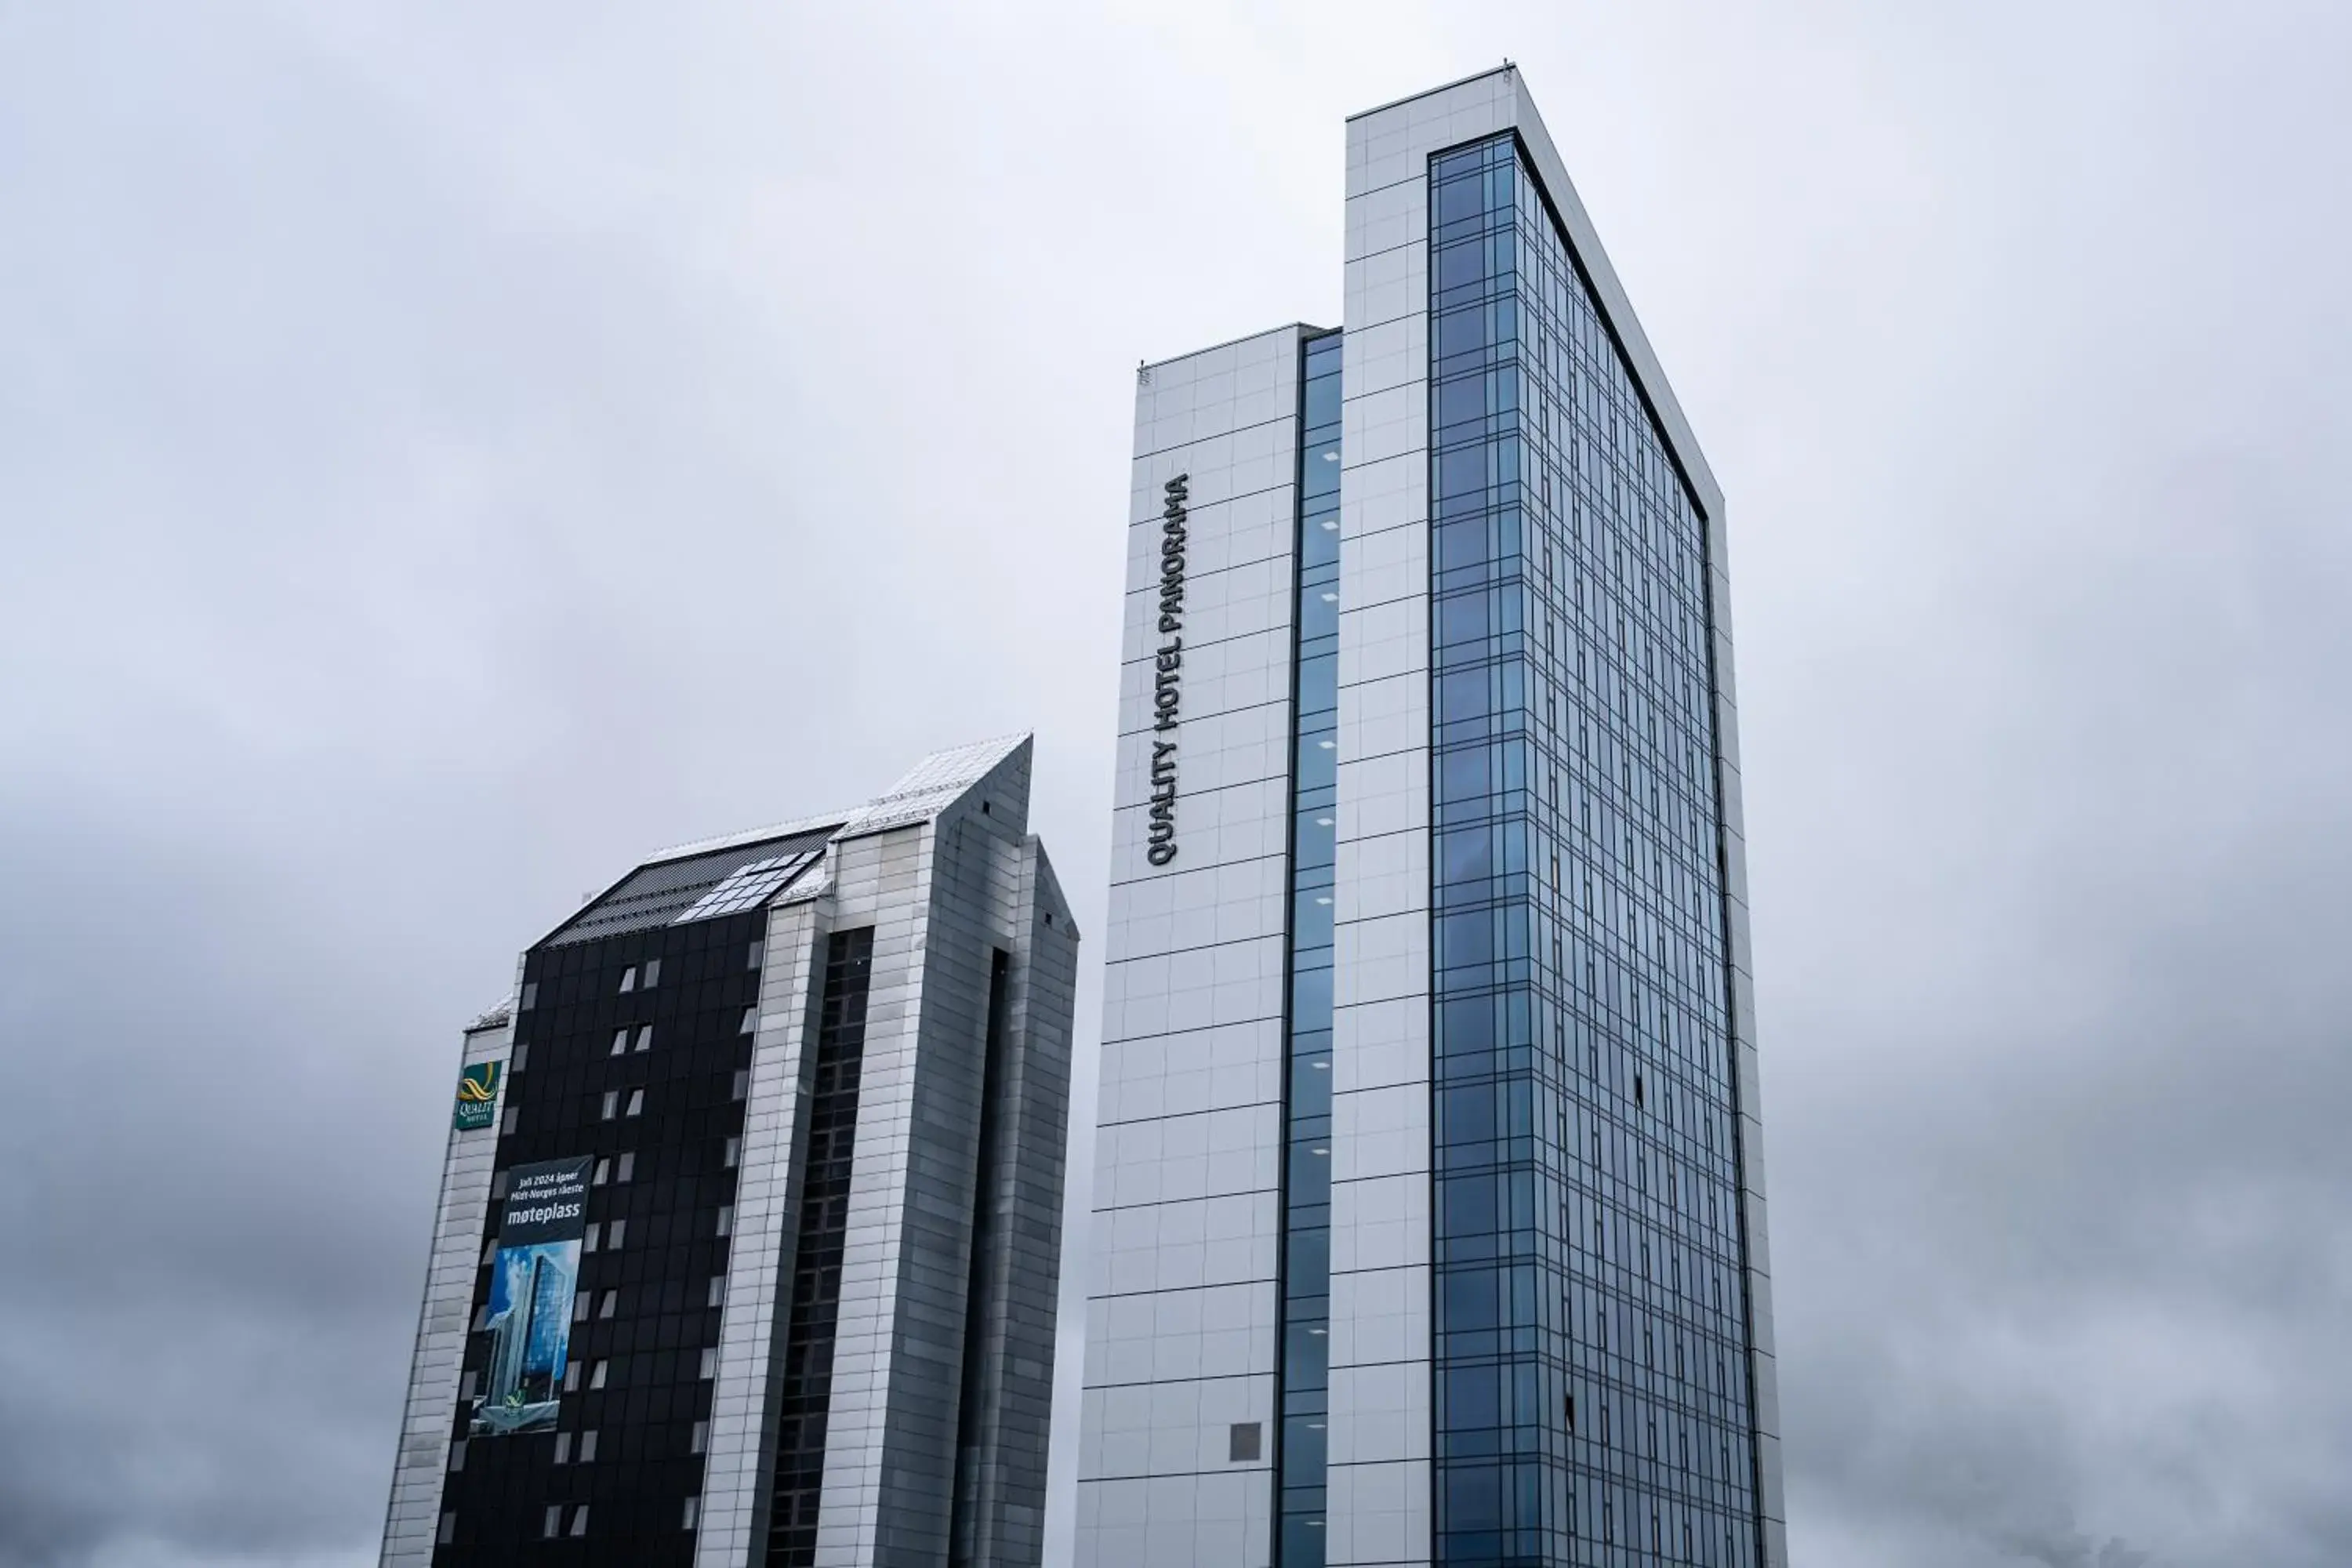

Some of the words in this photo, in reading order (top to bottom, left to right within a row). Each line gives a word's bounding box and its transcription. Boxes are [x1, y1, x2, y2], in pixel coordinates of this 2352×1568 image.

[1159, 473, 1189, 633] PANORAMA
[1154, 636, 1182, 731] HOTEL
[1148, 741, 1178, 866] QUALITY
[507, 1202, 580, 1225] møteplass
